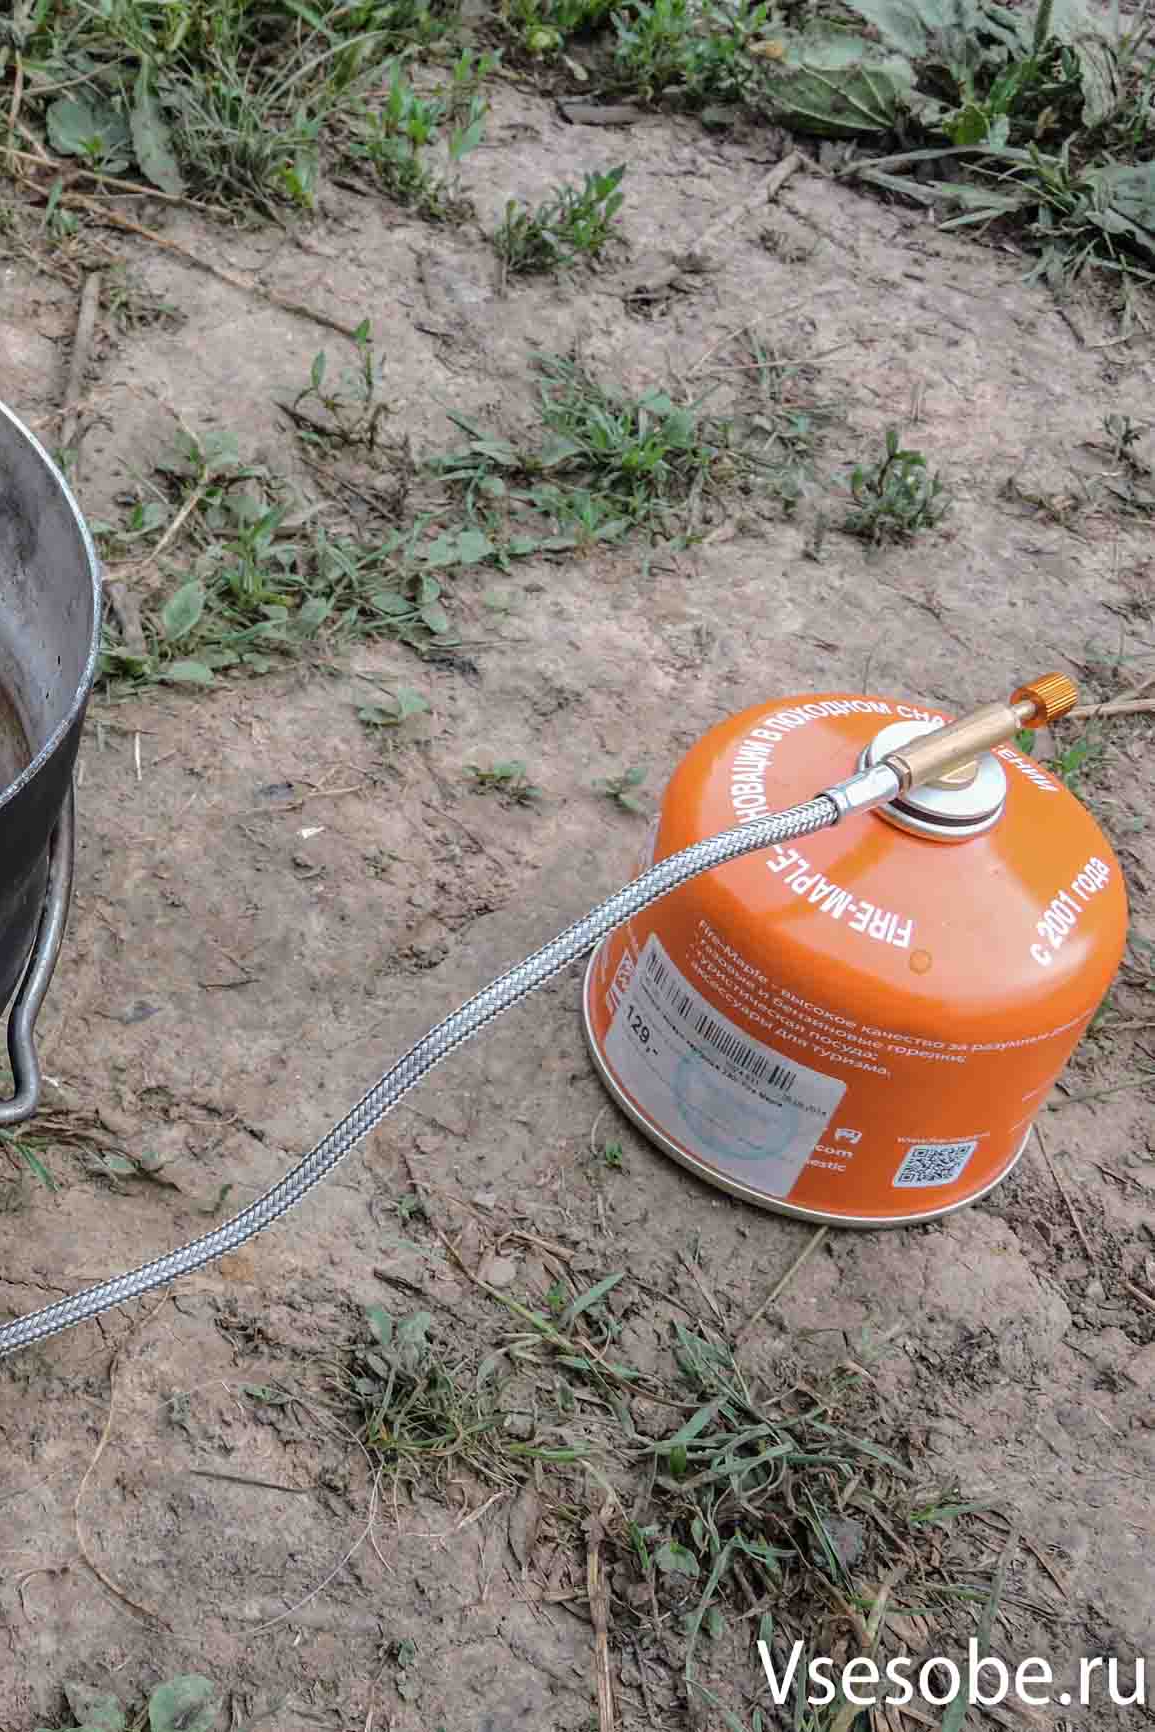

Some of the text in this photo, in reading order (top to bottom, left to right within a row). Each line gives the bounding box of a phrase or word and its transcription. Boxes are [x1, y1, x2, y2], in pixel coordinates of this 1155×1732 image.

[751, 726, 782, 741] В
[765, 700, 894, 733] ПОХОДНОМ
[731, 739, 776, 823] НОВАЦИИ
[1036, 890, 1083, 949] 2001
[1072, 856, 1111, 901] года
[782, 988, 857, 1029] высокое
[862, 1026, 945, 1050] качество
[814, 1143, 854, 1160] com
